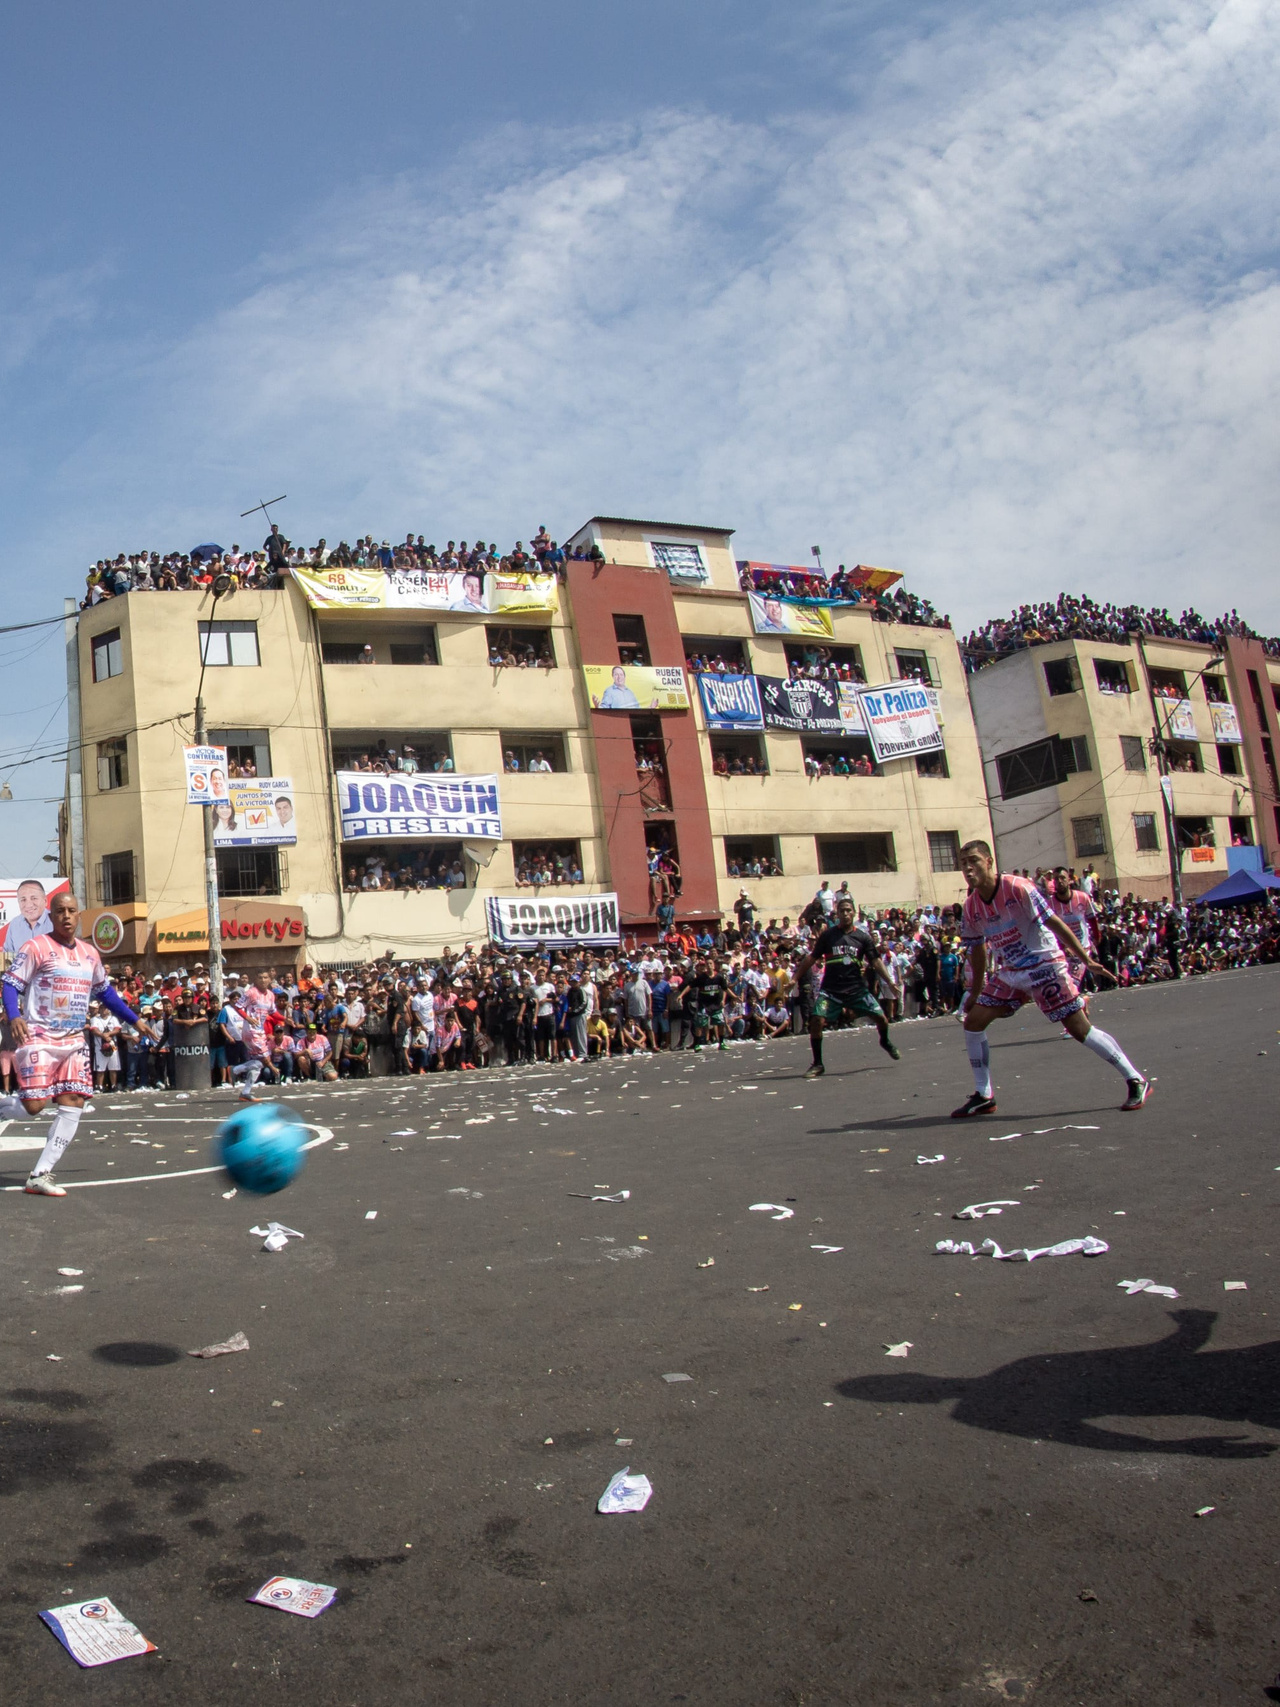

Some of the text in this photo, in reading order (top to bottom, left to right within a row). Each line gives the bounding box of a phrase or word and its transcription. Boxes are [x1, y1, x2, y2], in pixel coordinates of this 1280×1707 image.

[329, 574, 345, 584] 68
[655, 667, 681, 677] RUBÉN
[662, 678, 682, 686] CANO
[701, 677, 758, 716] CHAPITA
[864, 696, 884, 716] Dr
[883, 690, 928, 713] Paliza
[872, 714, 901, 725] Apoyando
[908, 709, 931, 719] Deporte
[878, 731, 942, 755] PORVENIR GRONE
[187, 753, 224, 761] CONTRERAS
[342, 780, 498, 815] JOAQUÍN
[344, 817, 501, 837] PRESENTE
[509, 900, 617, 937] JOAQUIN
[158, 930, 210, 941] POLLERI
[222, 917, 303, 940] Norty's
[54, 977, 78, 985] GRACIAS
